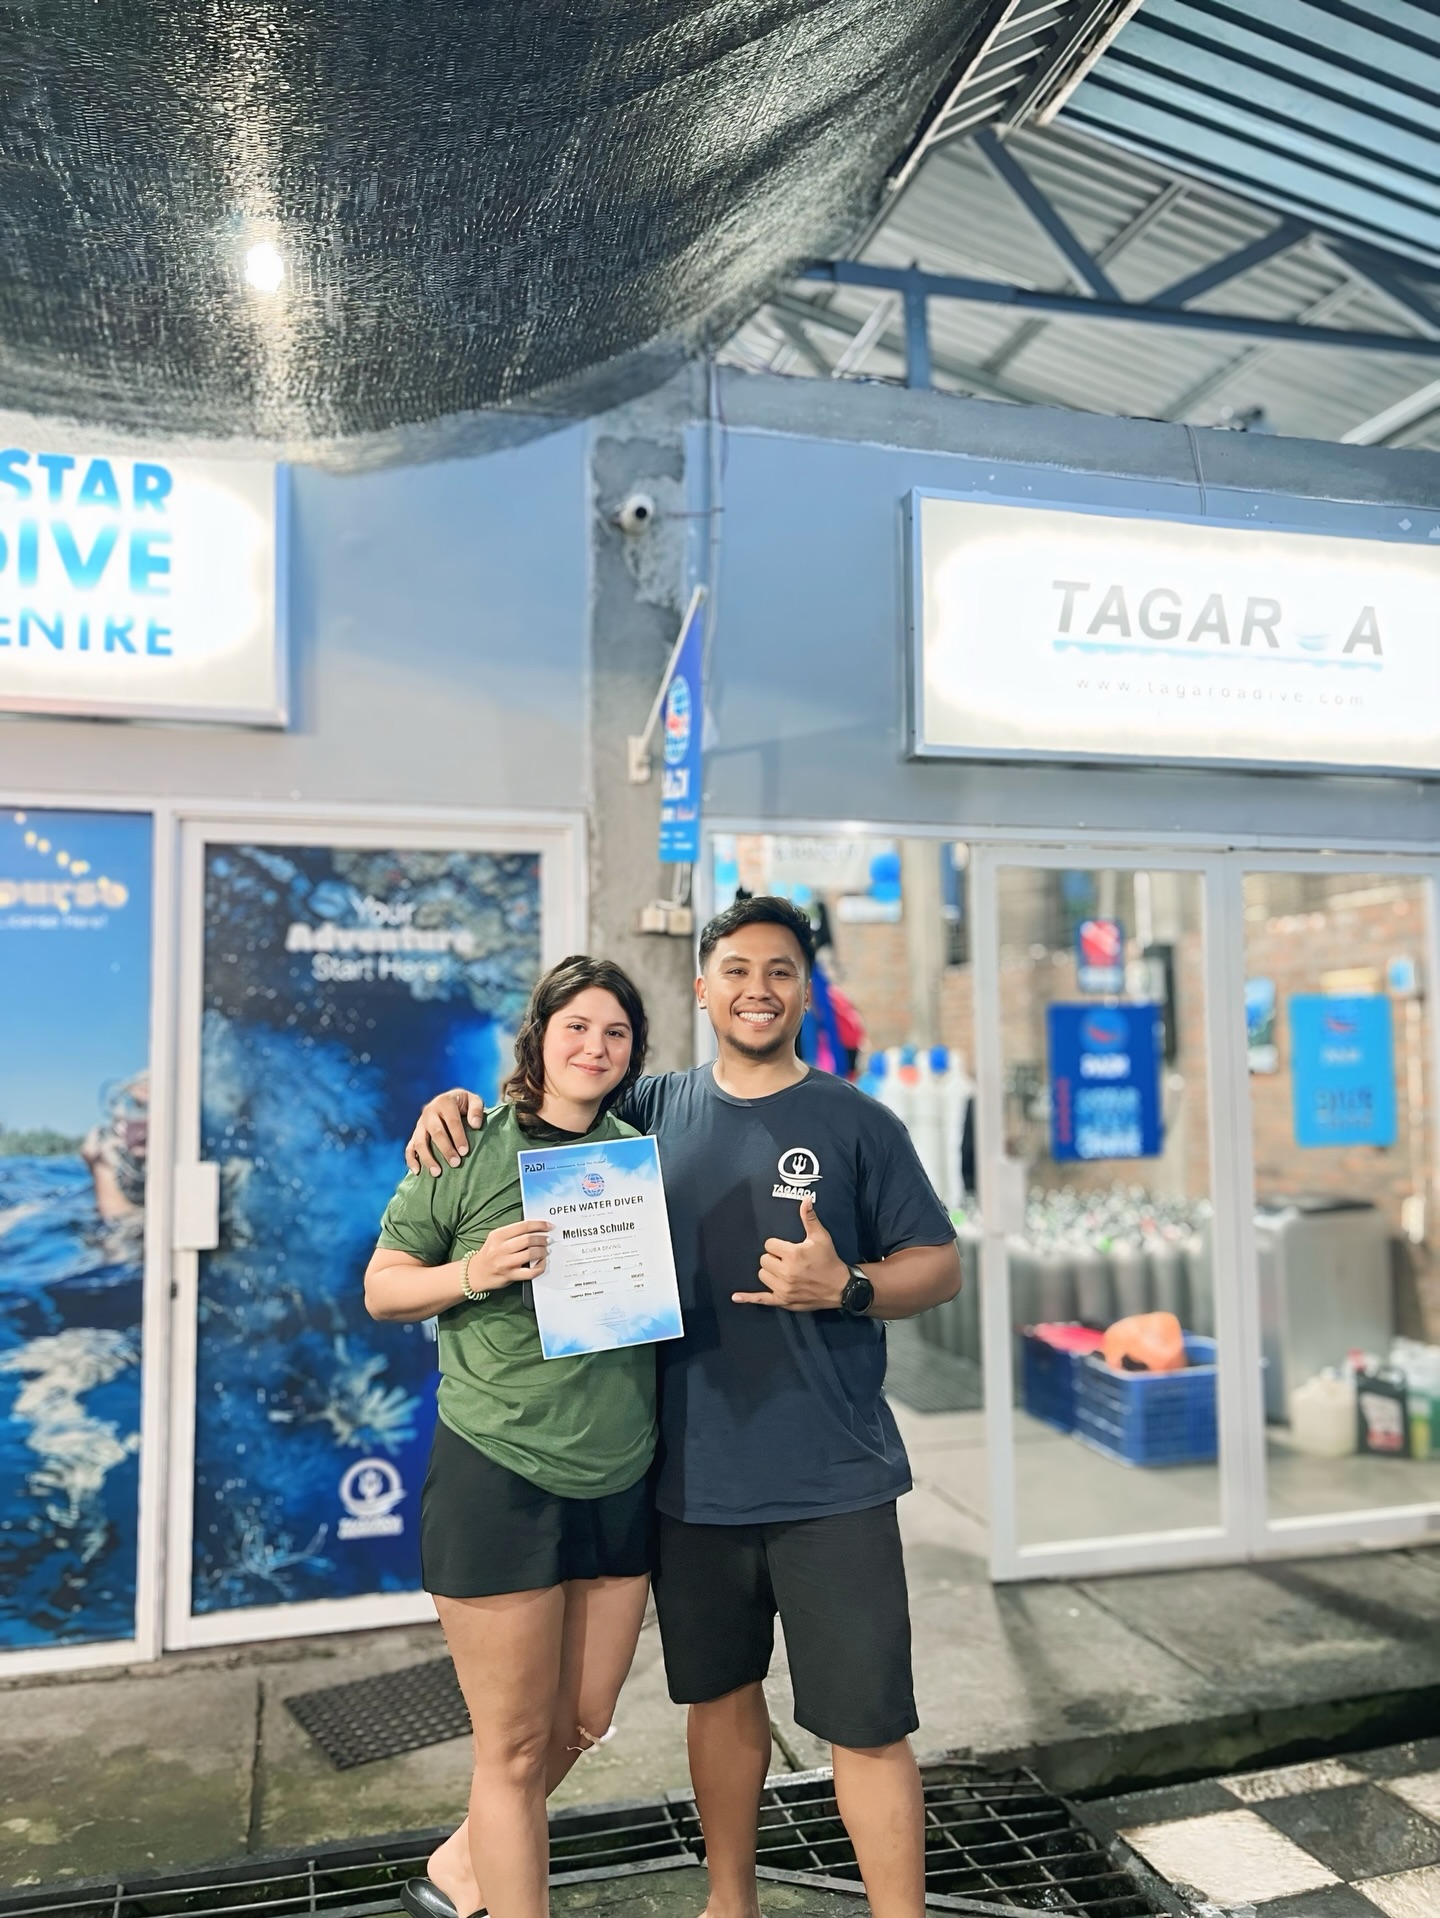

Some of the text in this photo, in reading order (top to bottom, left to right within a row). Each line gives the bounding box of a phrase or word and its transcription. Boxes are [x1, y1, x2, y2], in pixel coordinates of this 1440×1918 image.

[0, 448, 173, 513] STAR
[0, 518, 172, 596] IVE
[350, 895, 417, 926] Your
[285, 921, 475, 953] Adventure
[524, 1163, 546, 1173] PADI
[549, 1204, 577, 1215] OPEN
[578, 1199, 612, 1211] WATER
[614, 1195, 644, 1207] DIVER
[562, 1228, 598, 1239] Melissa
[600, 1221, 635, 1235] Schulze
